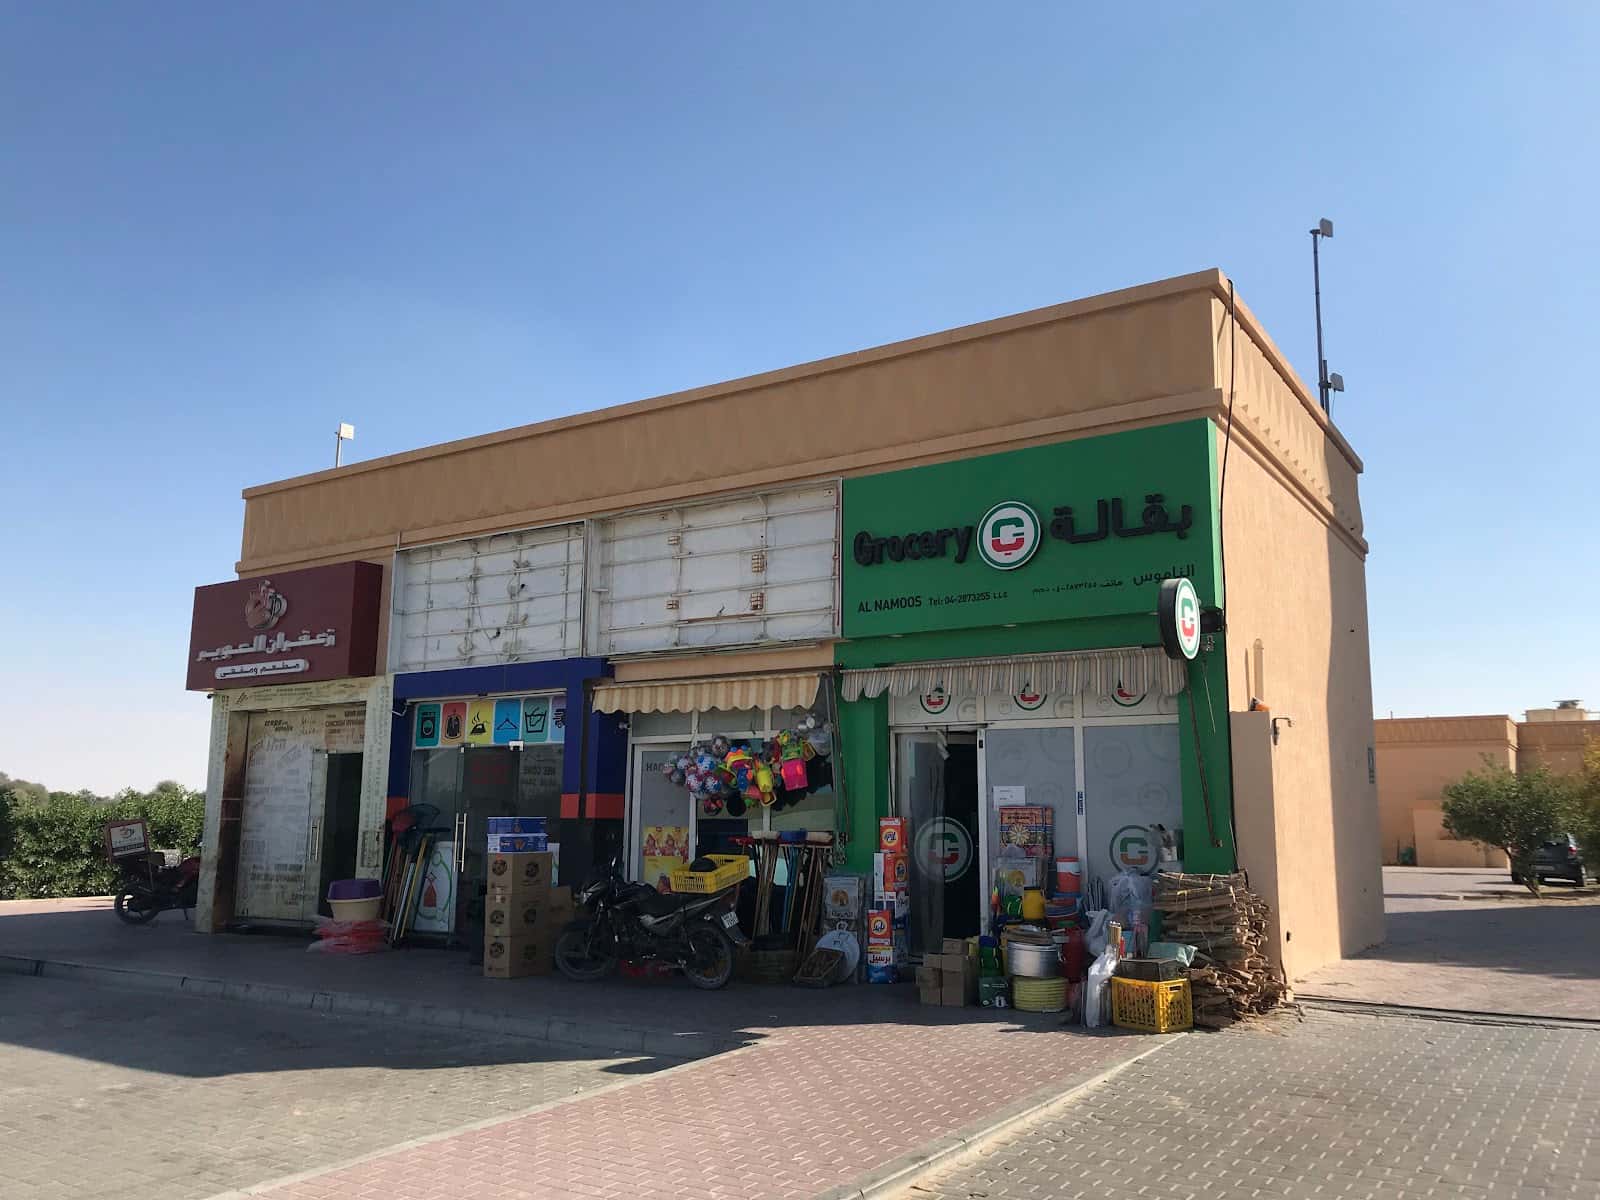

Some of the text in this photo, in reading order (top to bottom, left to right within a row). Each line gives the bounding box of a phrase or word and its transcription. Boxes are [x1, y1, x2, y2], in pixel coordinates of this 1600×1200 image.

[1049, 492, 1194, 545] بقالة
[853, 524, 974, 567] Grocery
[858, 600, 872, 614] AL
[874, 596, 922, 612] NAMOOS
